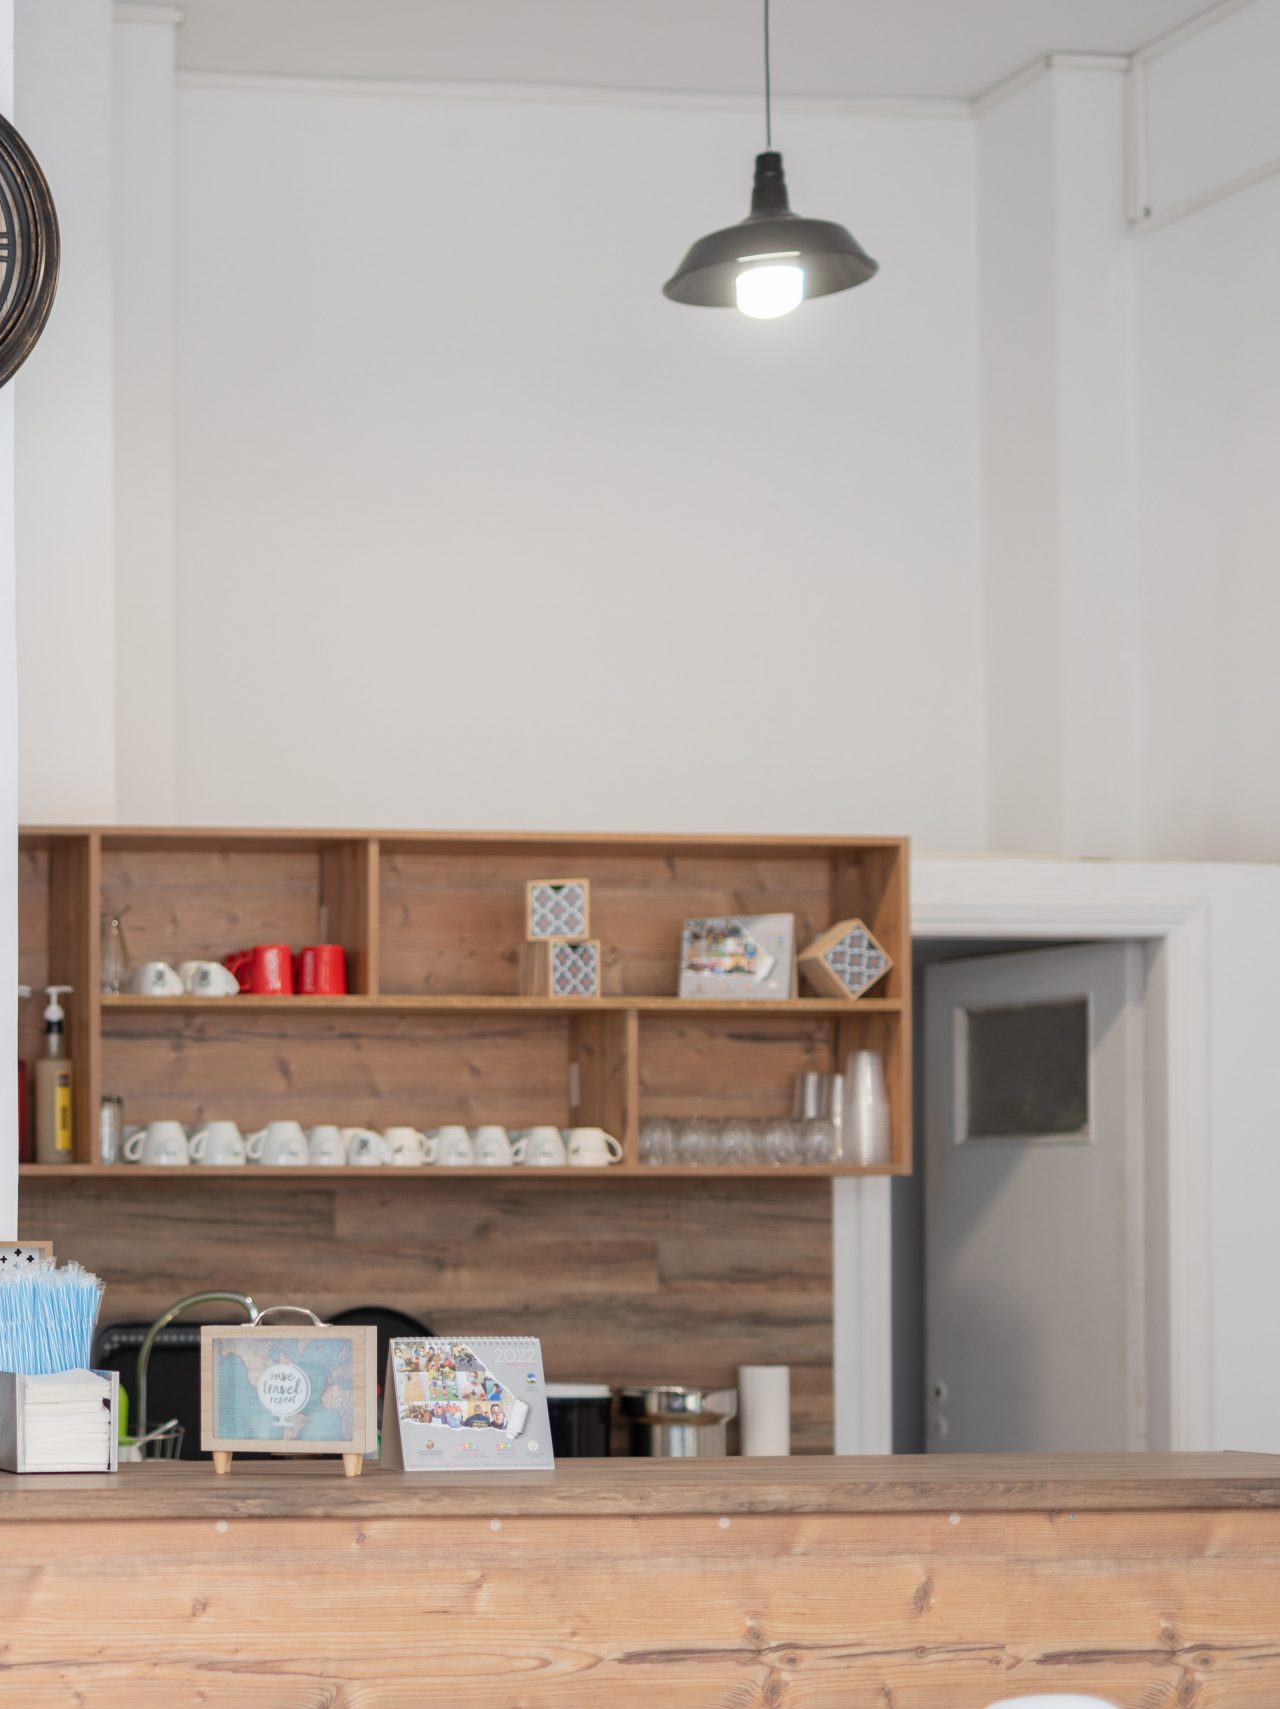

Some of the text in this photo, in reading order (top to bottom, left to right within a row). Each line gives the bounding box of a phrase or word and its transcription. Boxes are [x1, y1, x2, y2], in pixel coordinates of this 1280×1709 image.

[494, 1347, 536, 1363] 2022
[263, 1377, 302, 1396] travel
[270, 1394, 296, 1407] repeat
